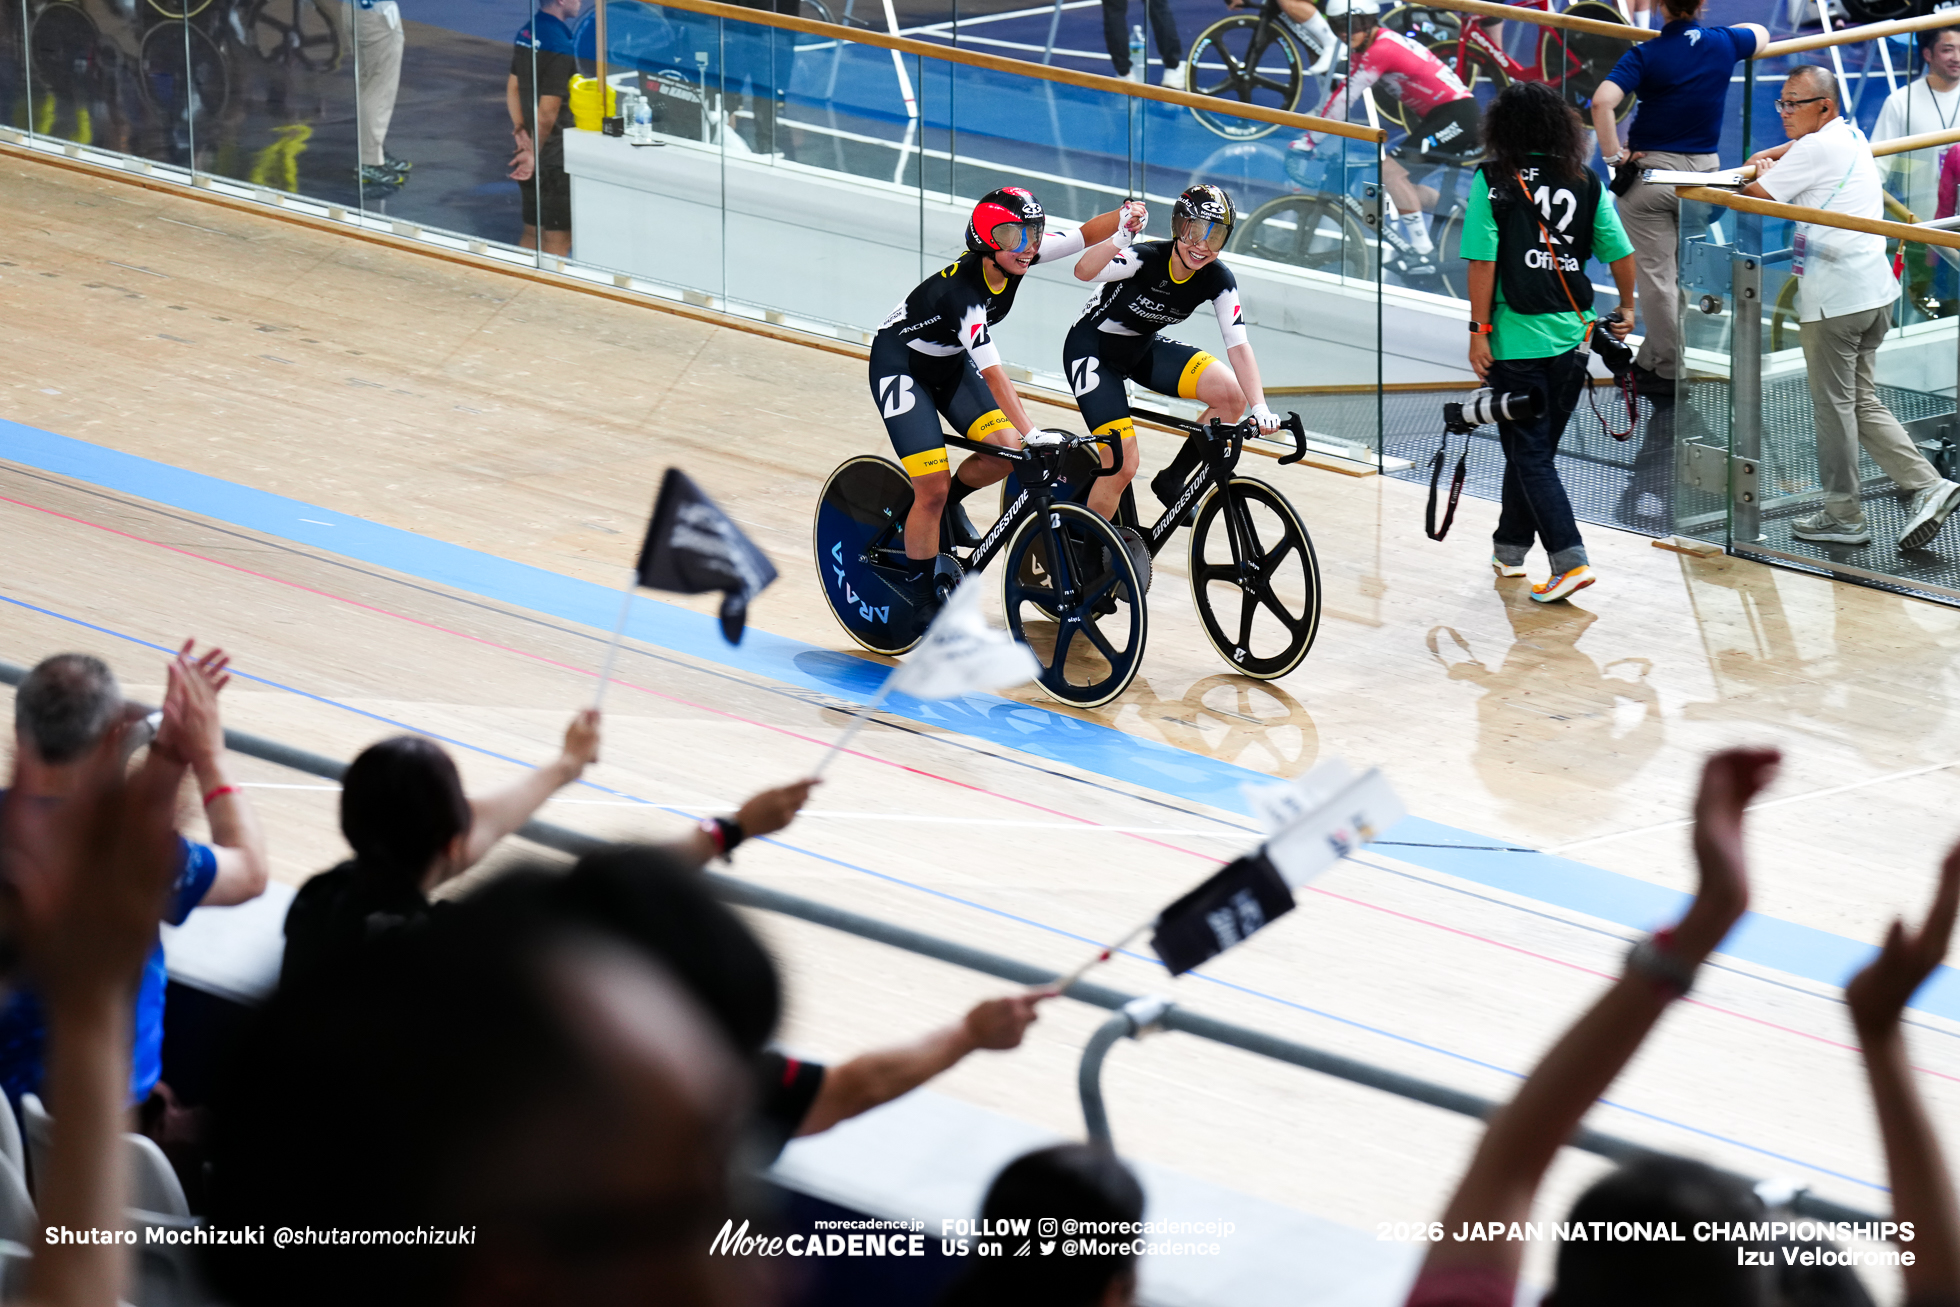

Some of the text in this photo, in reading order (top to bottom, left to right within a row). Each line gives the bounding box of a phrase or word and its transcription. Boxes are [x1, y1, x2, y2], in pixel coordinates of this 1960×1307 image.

[1533, 185, 1577, 245] 12
[1524, 248, 1580, 272] Officia
[1090, 282, 1124, 321] ANCHOR
[898, 314, 942, 336] ANCHOR
[1190, 360, 1203, 374] ONE
[980, 418, 995, 431] ONE
[923, 459, 939, 468] TWO
[971, 488, 1029, 567] BRIDGESTONE
